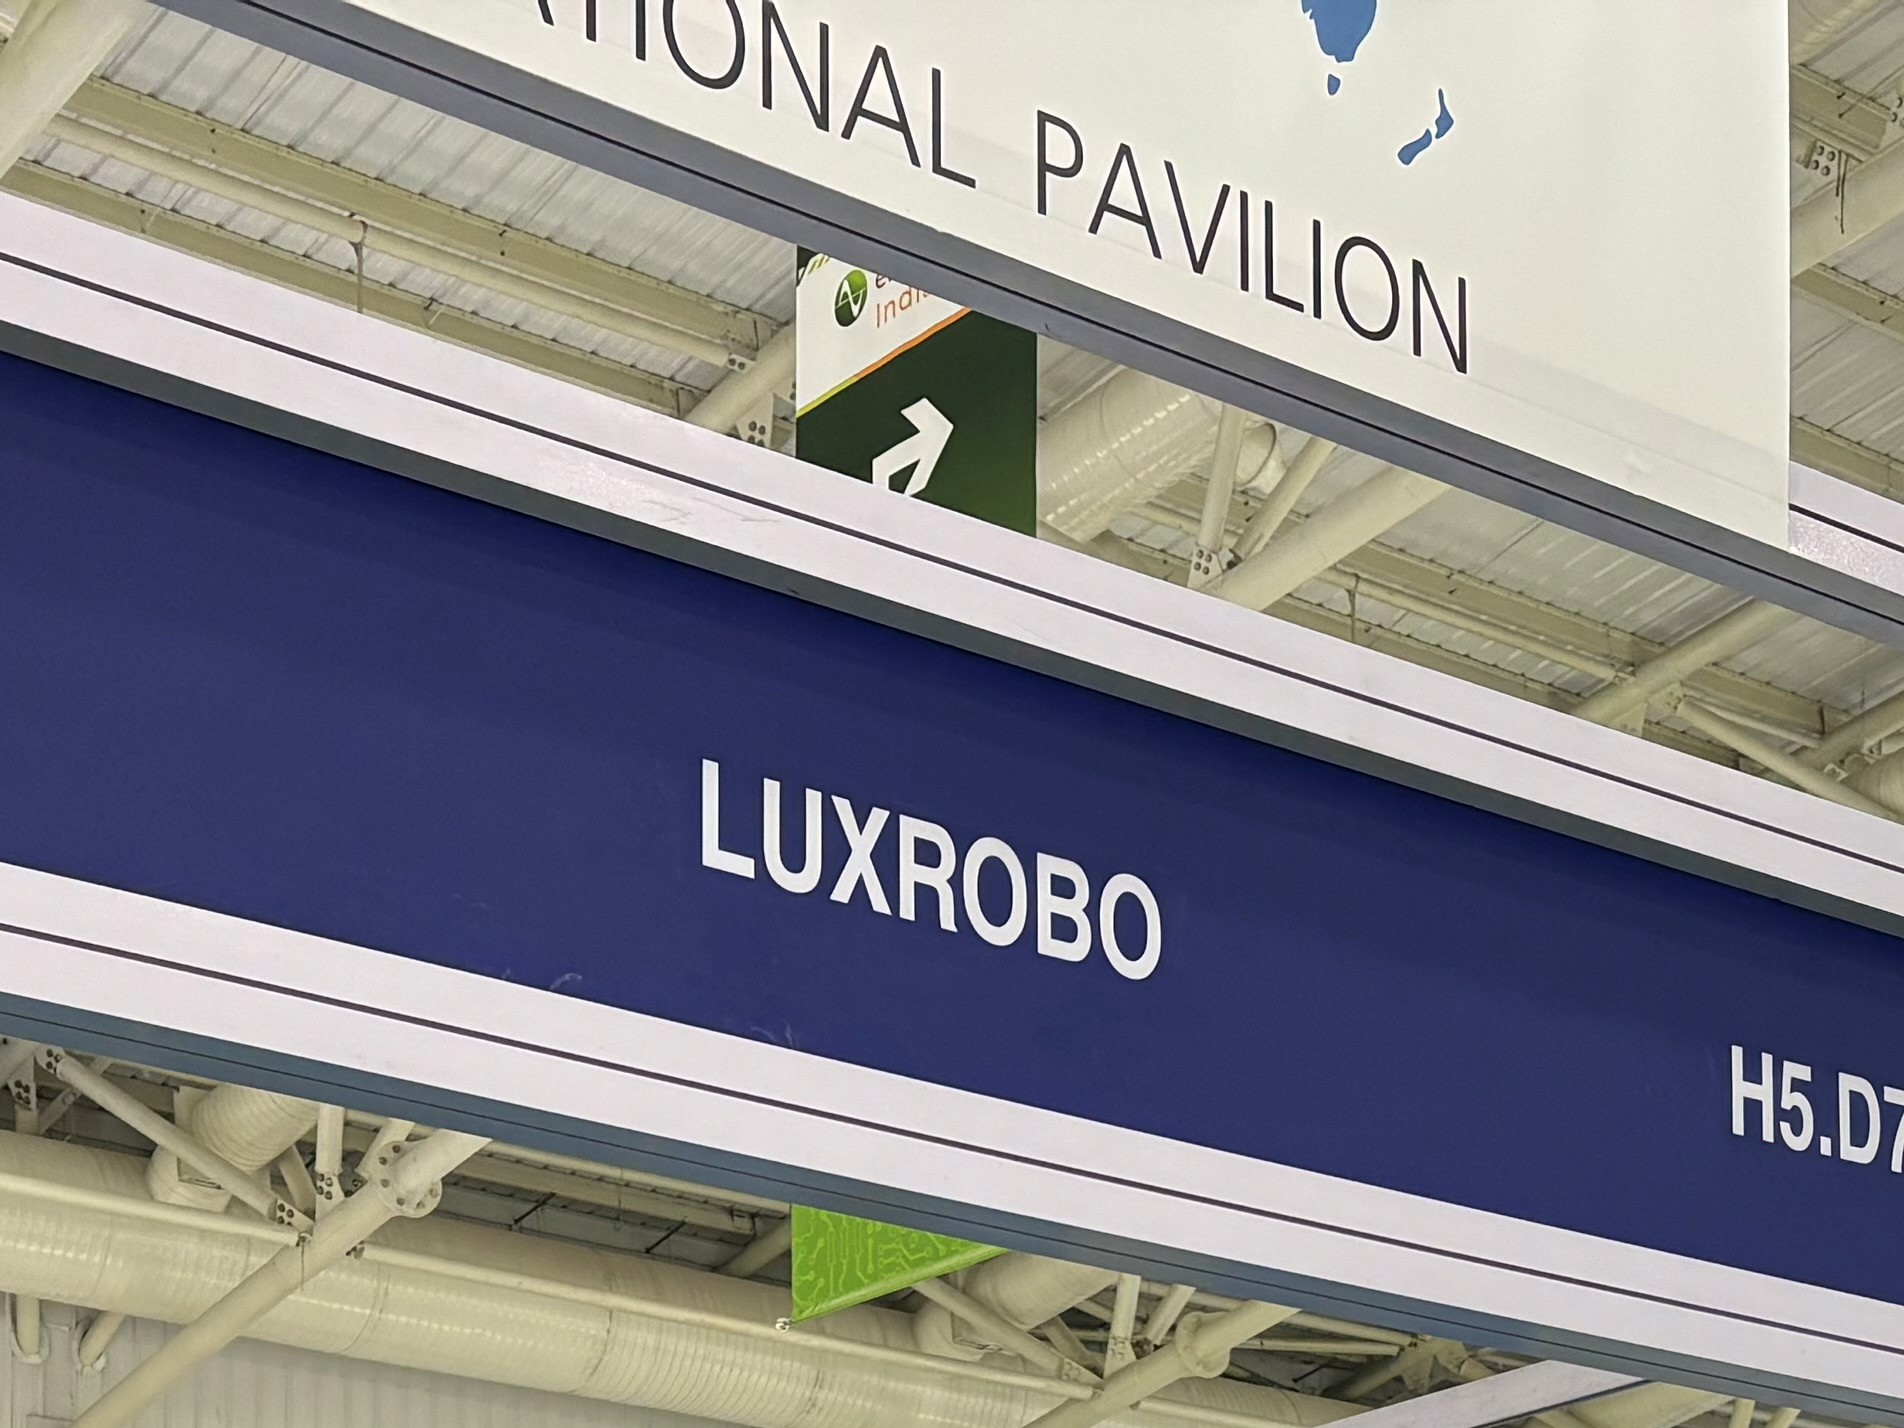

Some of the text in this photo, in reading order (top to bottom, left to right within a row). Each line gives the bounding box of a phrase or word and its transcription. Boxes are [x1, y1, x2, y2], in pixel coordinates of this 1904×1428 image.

[875, 286, 930, 328] Indi
[1037, 109, 1472, 377] PAVILION
[700, 758, 1164, 983] LUXROBO
